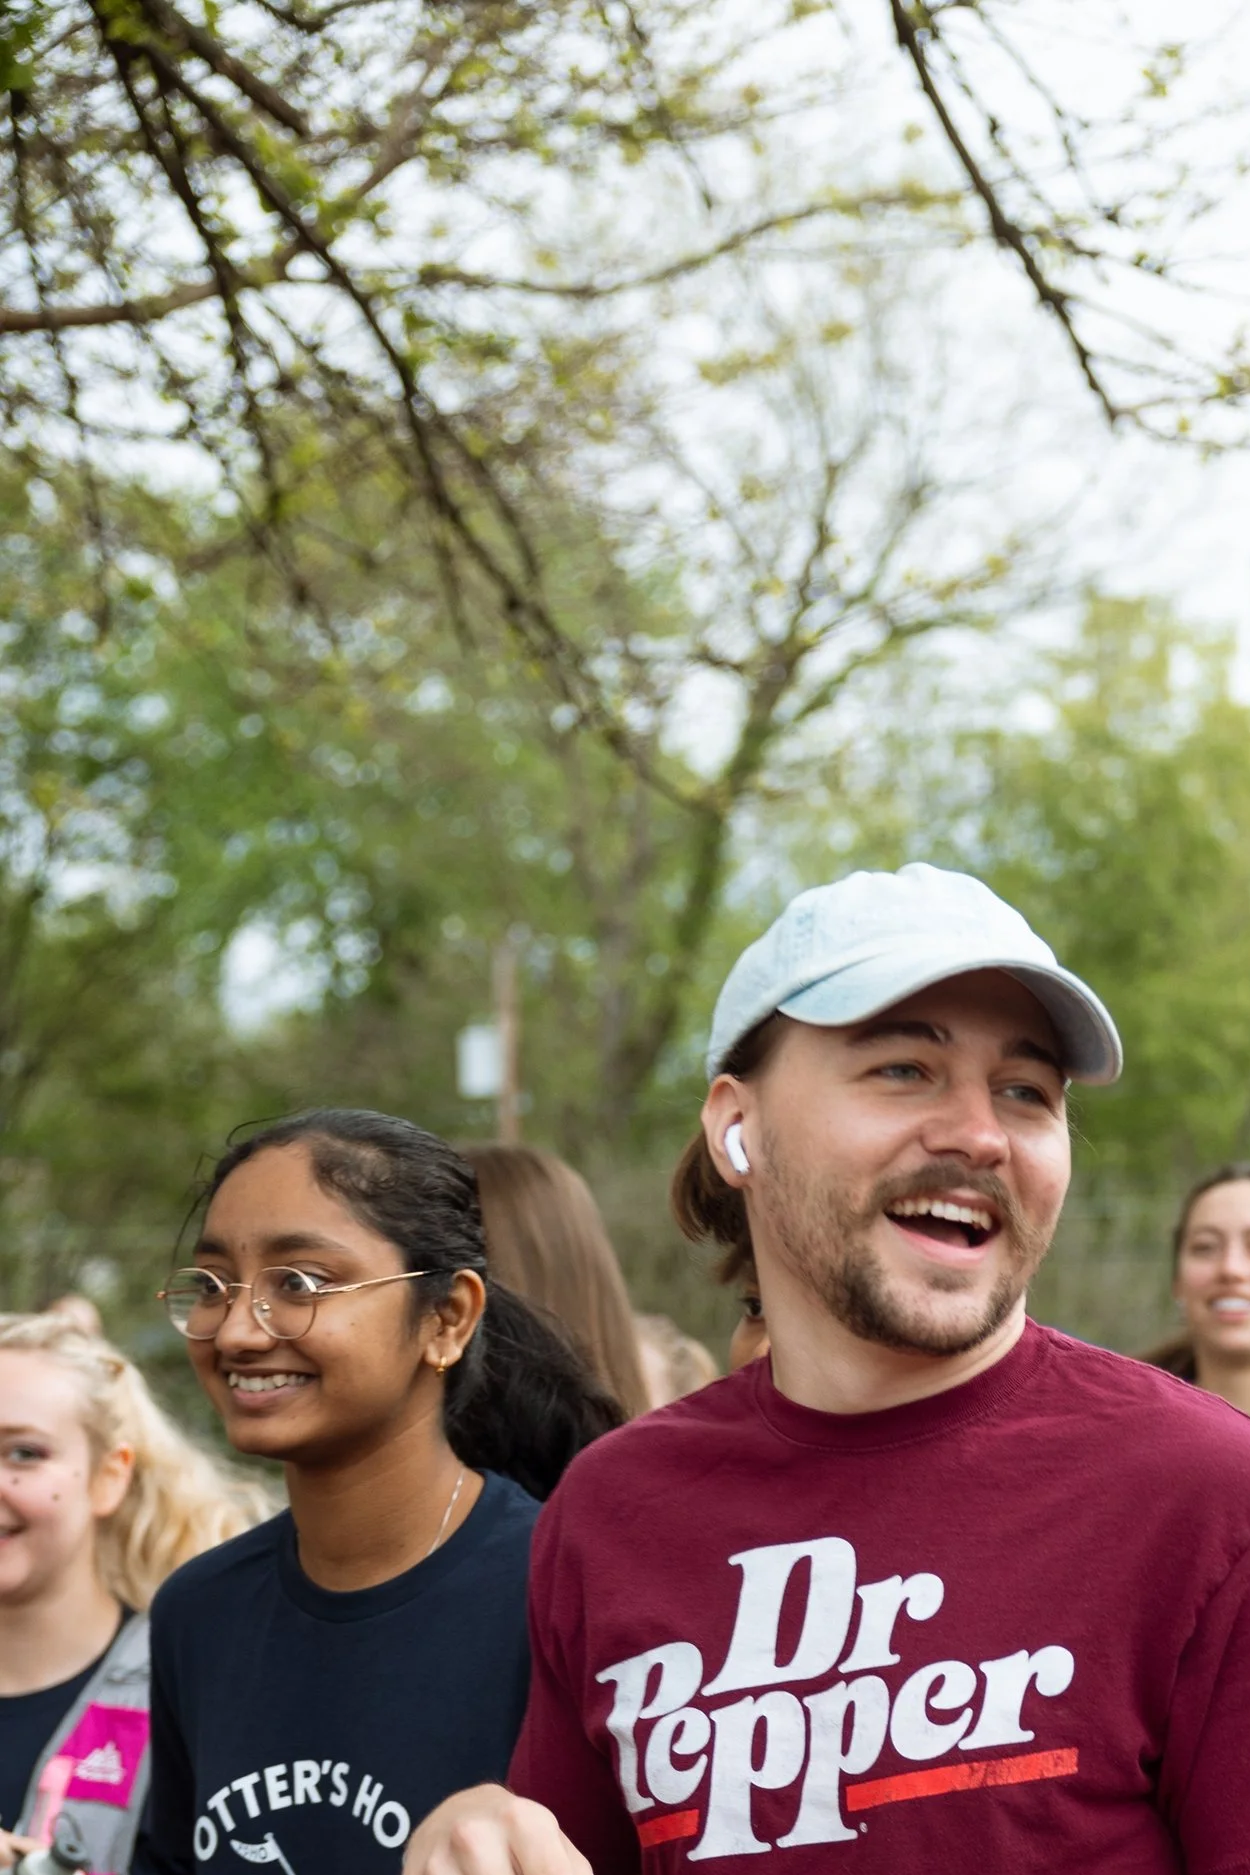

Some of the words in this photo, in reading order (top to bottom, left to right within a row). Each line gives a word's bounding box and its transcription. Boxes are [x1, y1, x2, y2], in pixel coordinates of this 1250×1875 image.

[702, 1536, 944, 1697] Dr
[352, 1774, 411, 1849] HO
[595, 1641, 1075, 1862] Pepper
